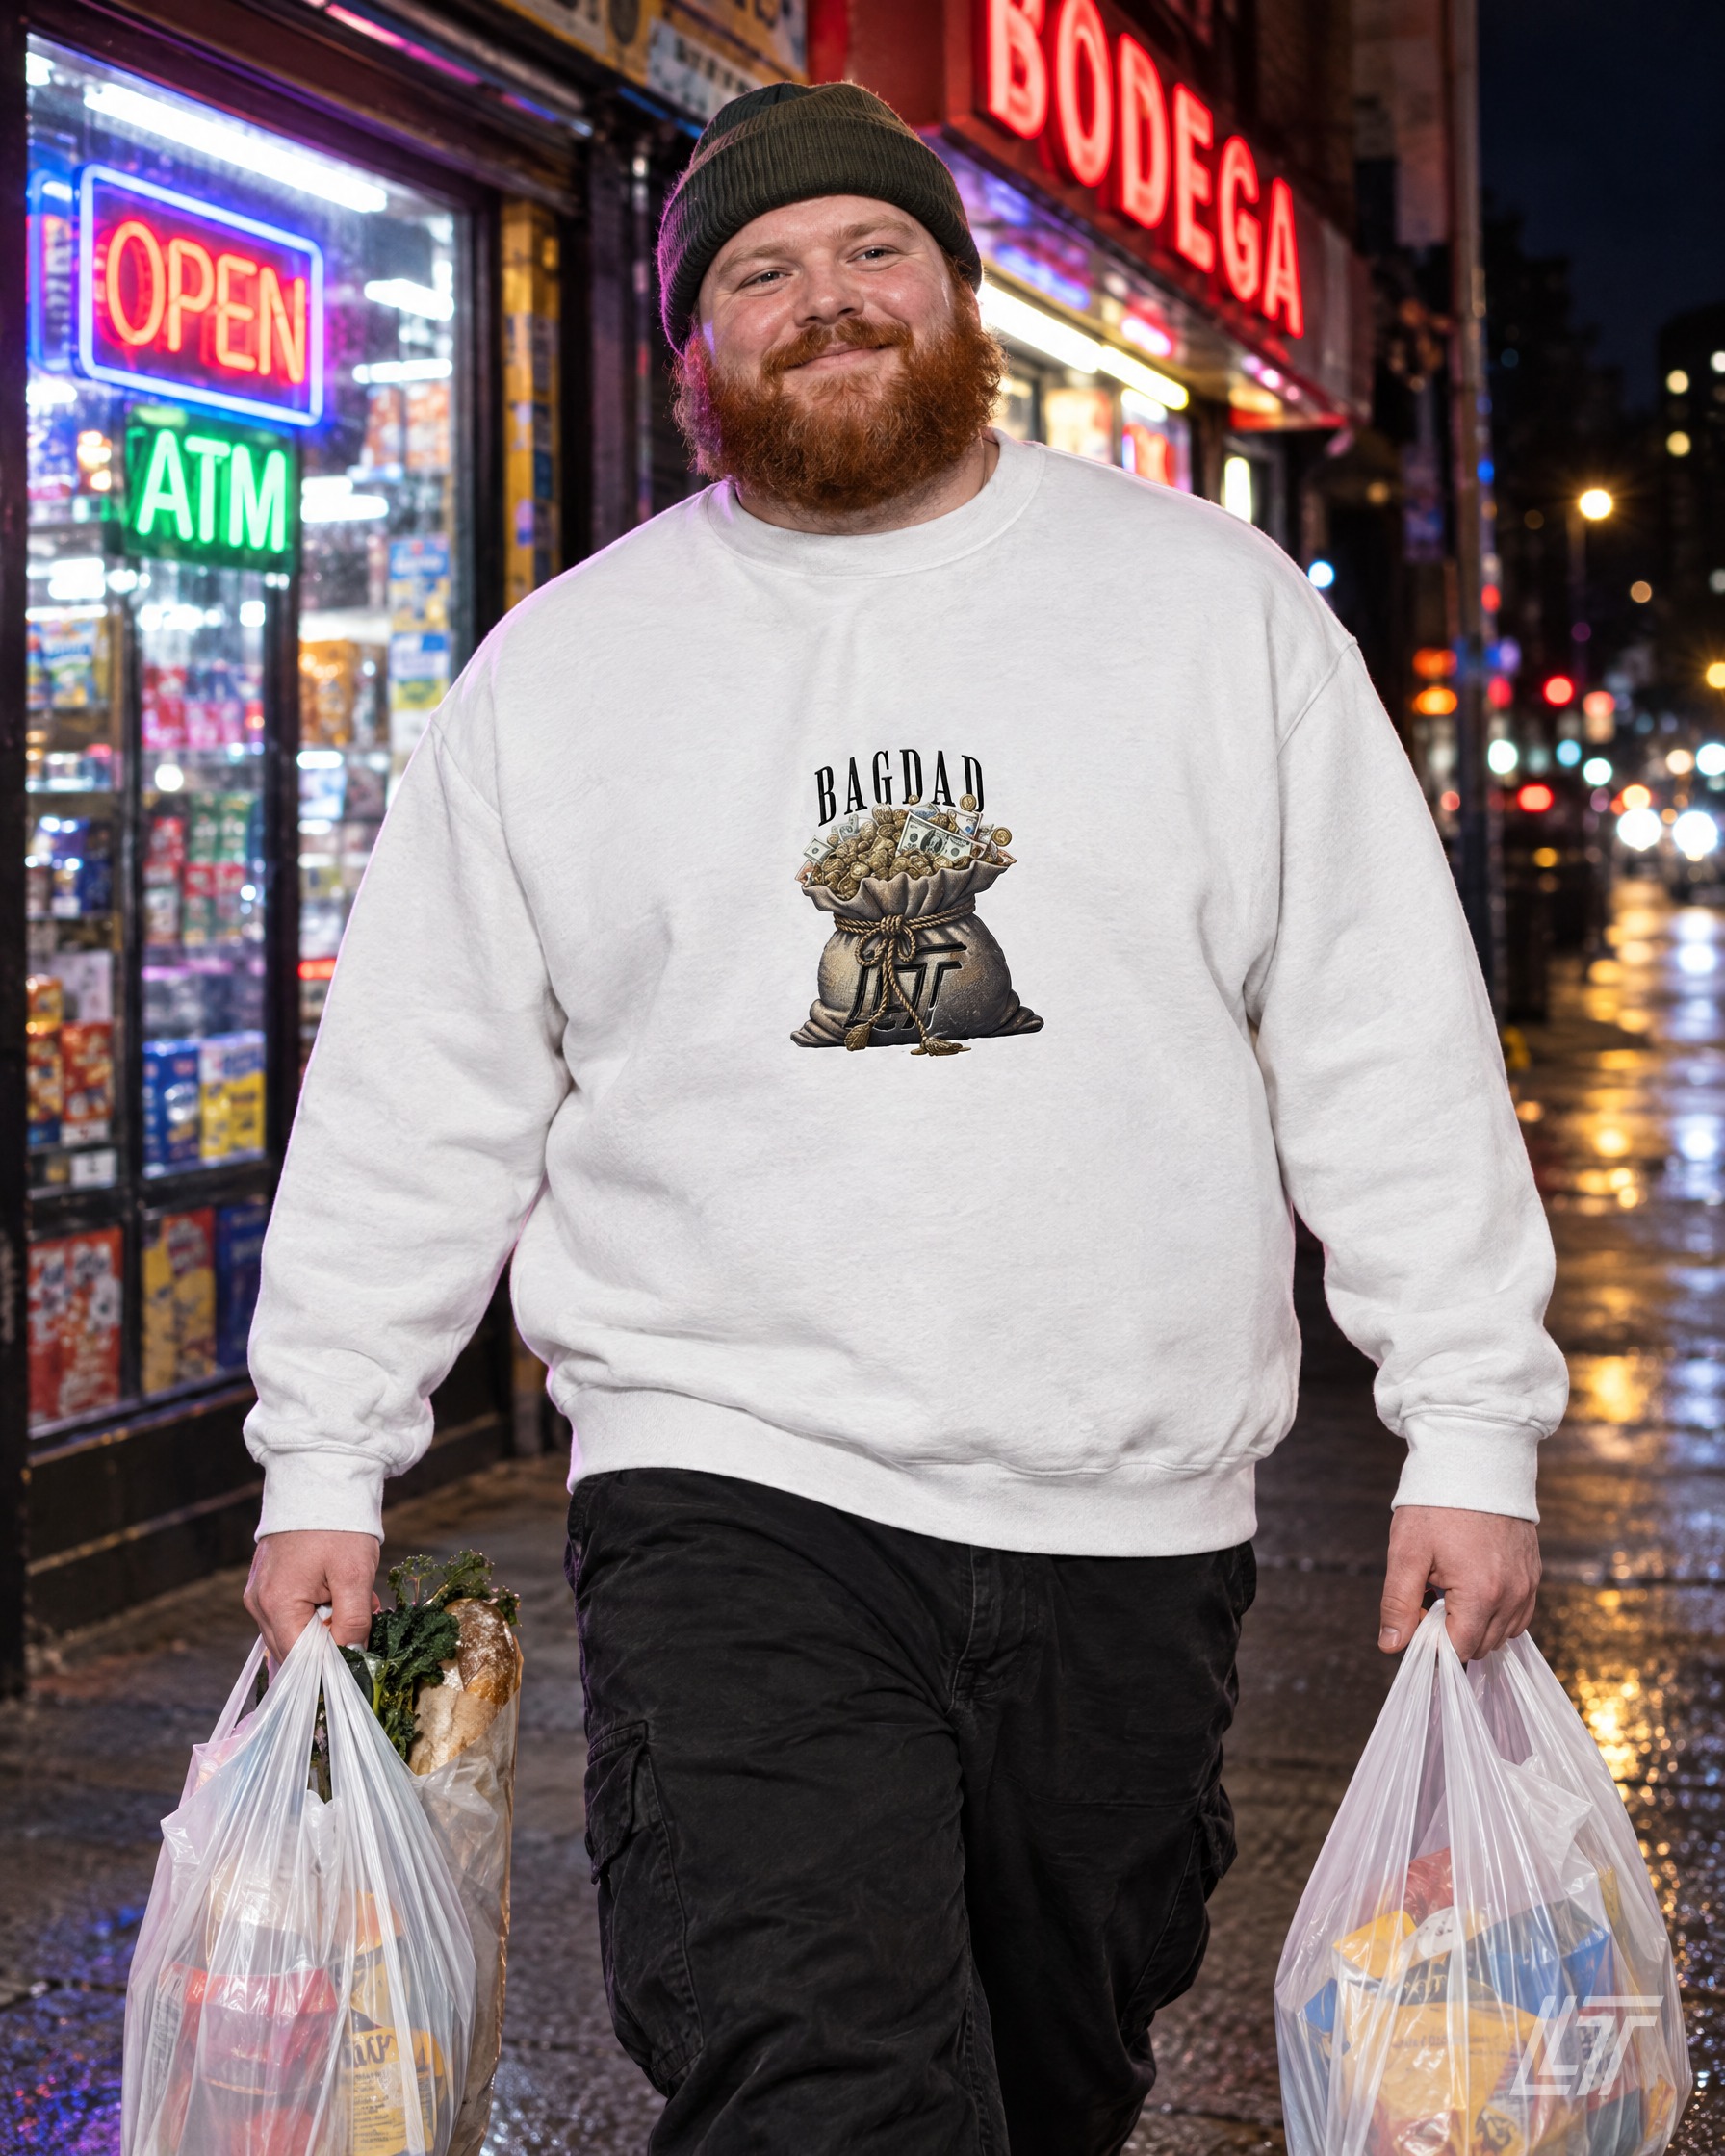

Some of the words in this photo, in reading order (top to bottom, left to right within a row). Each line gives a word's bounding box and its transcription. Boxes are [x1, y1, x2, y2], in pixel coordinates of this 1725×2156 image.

[987, 0, 1304, 340] BODEGA
[105, 220, 306, 385] OPEN
[136, 427, 288, 553] ATM
[814, 748, 985, 827] BAGDAD
